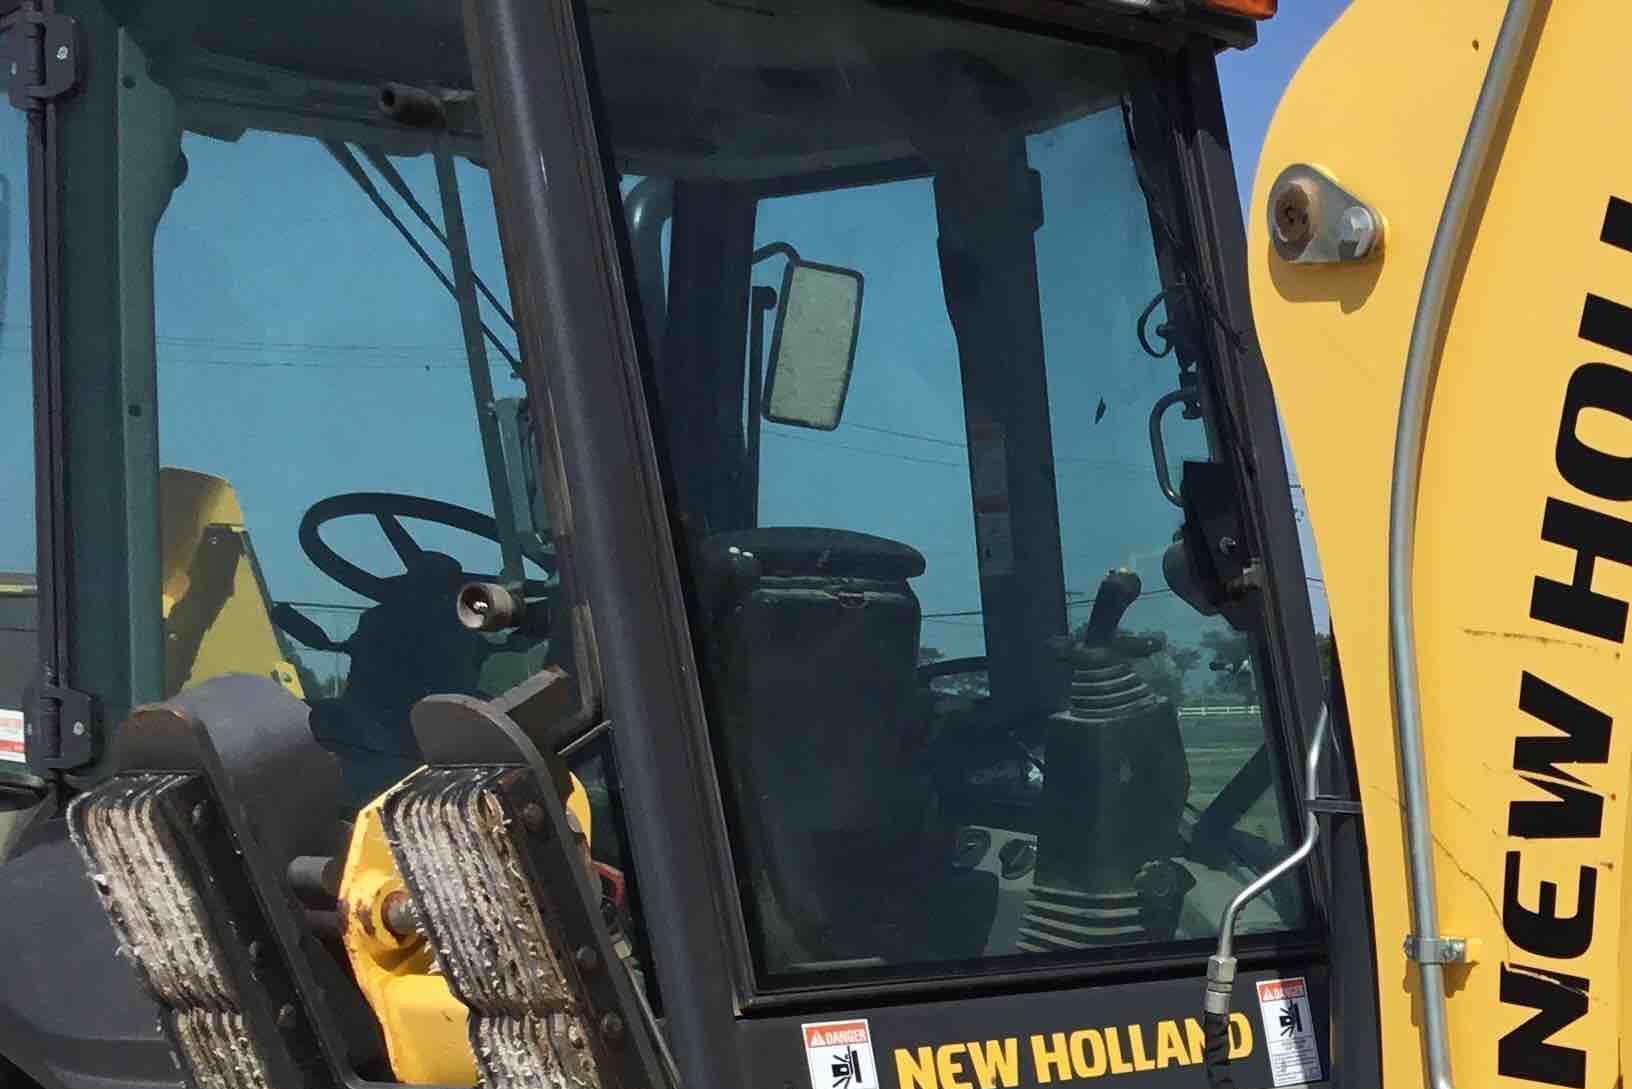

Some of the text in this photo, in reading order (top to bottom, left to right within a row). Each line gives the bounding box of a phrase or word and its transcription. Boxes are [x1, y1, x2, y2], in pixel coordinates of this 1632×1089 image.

[1498, 670, 1613, 1089] NEW
[824, 1028, 867, 1046] DANGER
[1031, 1011, 1254, 1085] HOLLAND
